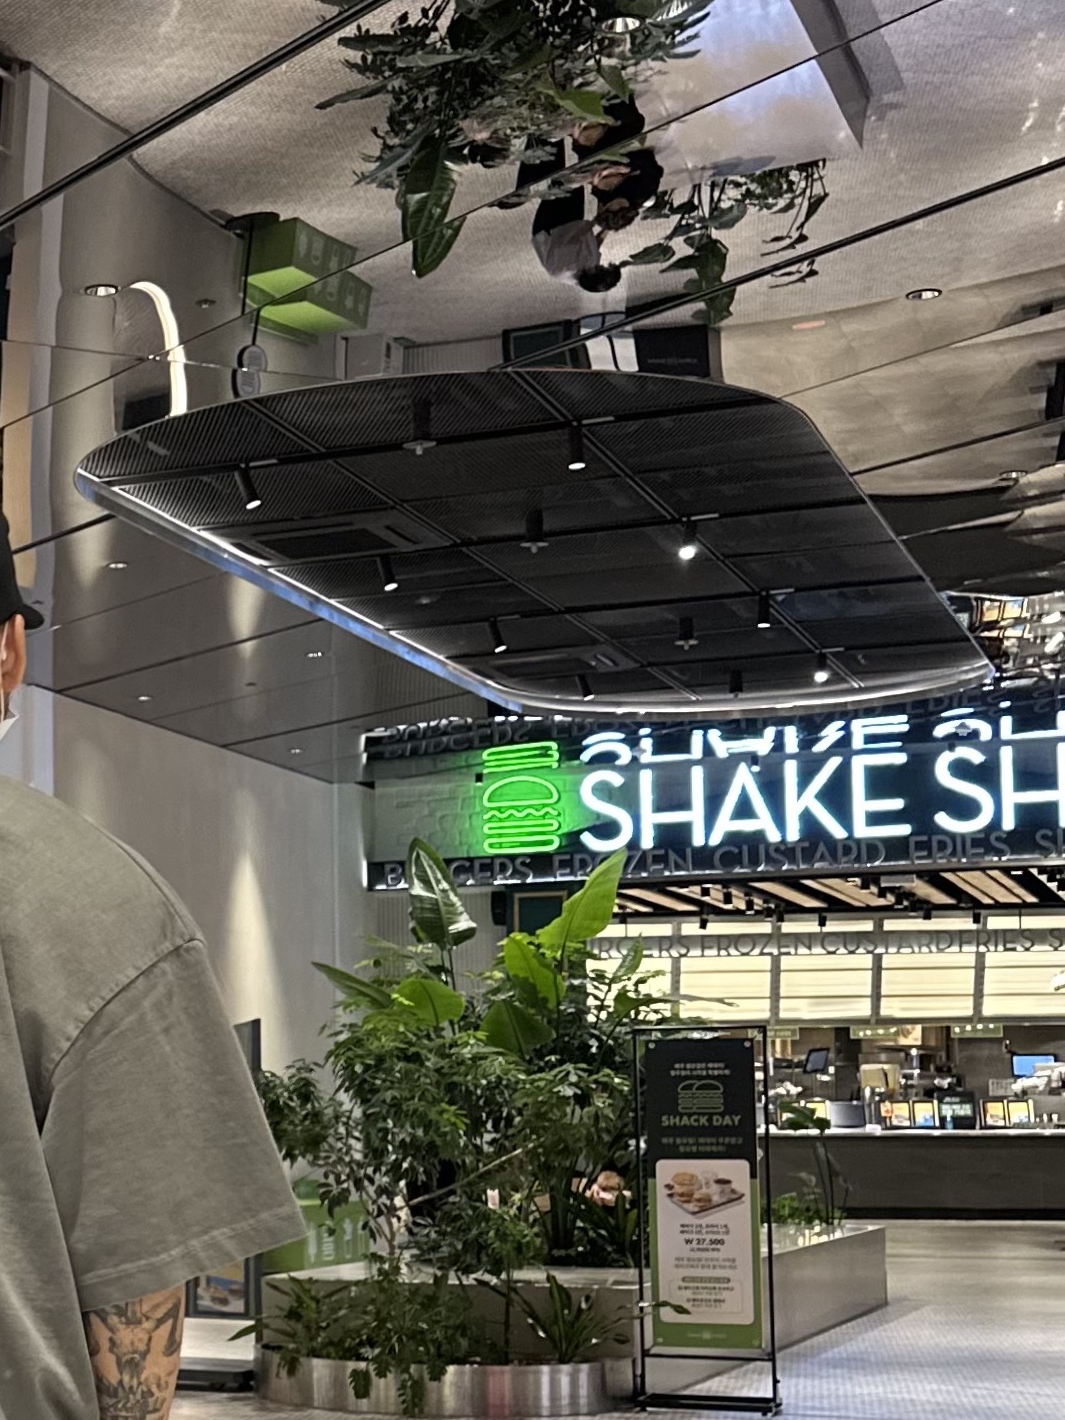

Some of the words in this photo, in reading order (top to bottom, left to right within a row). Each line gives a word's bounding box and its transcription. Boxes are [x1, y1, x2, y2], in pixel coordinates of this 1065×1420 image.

[580, 752, 912, 852] SHAKE
[384, 855, 533, 888] BGERS
[700, 933, 813, 957] FROZEN
[820, 929, 954, 956] CUSTARD
[958, 928, 1035, 953] FRIES
[661, 1114, 710, 1127] SHACK
[712, 1114, 742, 1127] DAY
